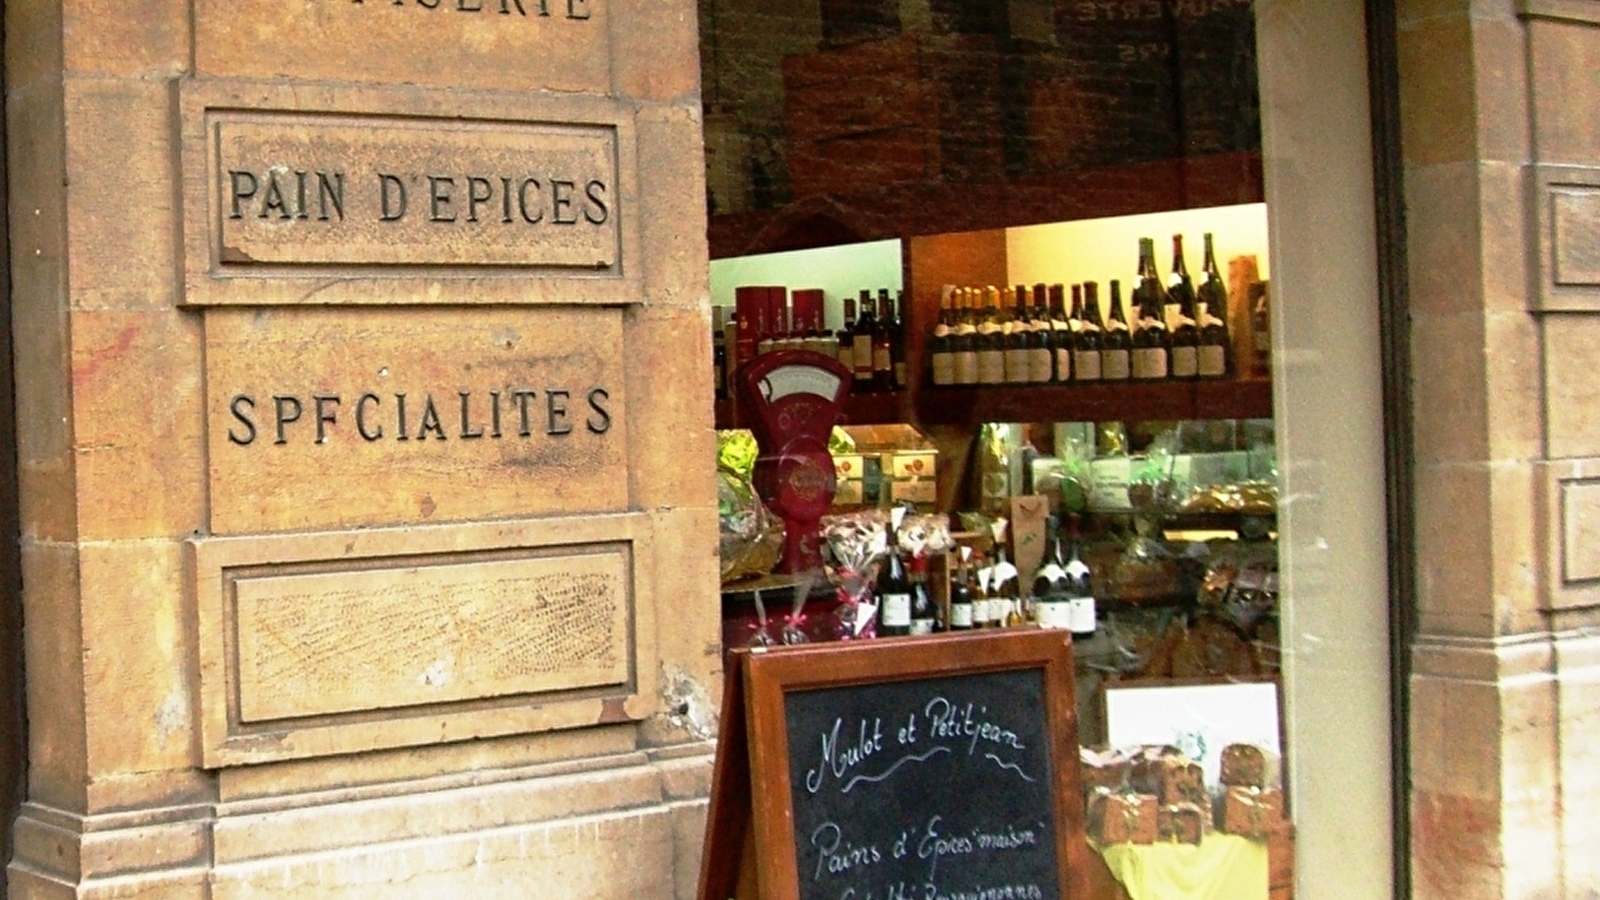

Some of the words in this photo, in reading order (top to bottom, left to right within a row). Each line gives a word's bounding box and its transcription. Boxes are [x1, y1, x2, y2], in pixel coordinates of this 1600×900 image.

[228, 169, 345, 221] PAIN
[379, 172, 609, 225] D'EPICES
[807, 717, 882, 793] Mulot
[898, 713, 917, 744] et
[926, 696, 1025, 756] Petitjean
[811, 821, 881, 880] Pains
